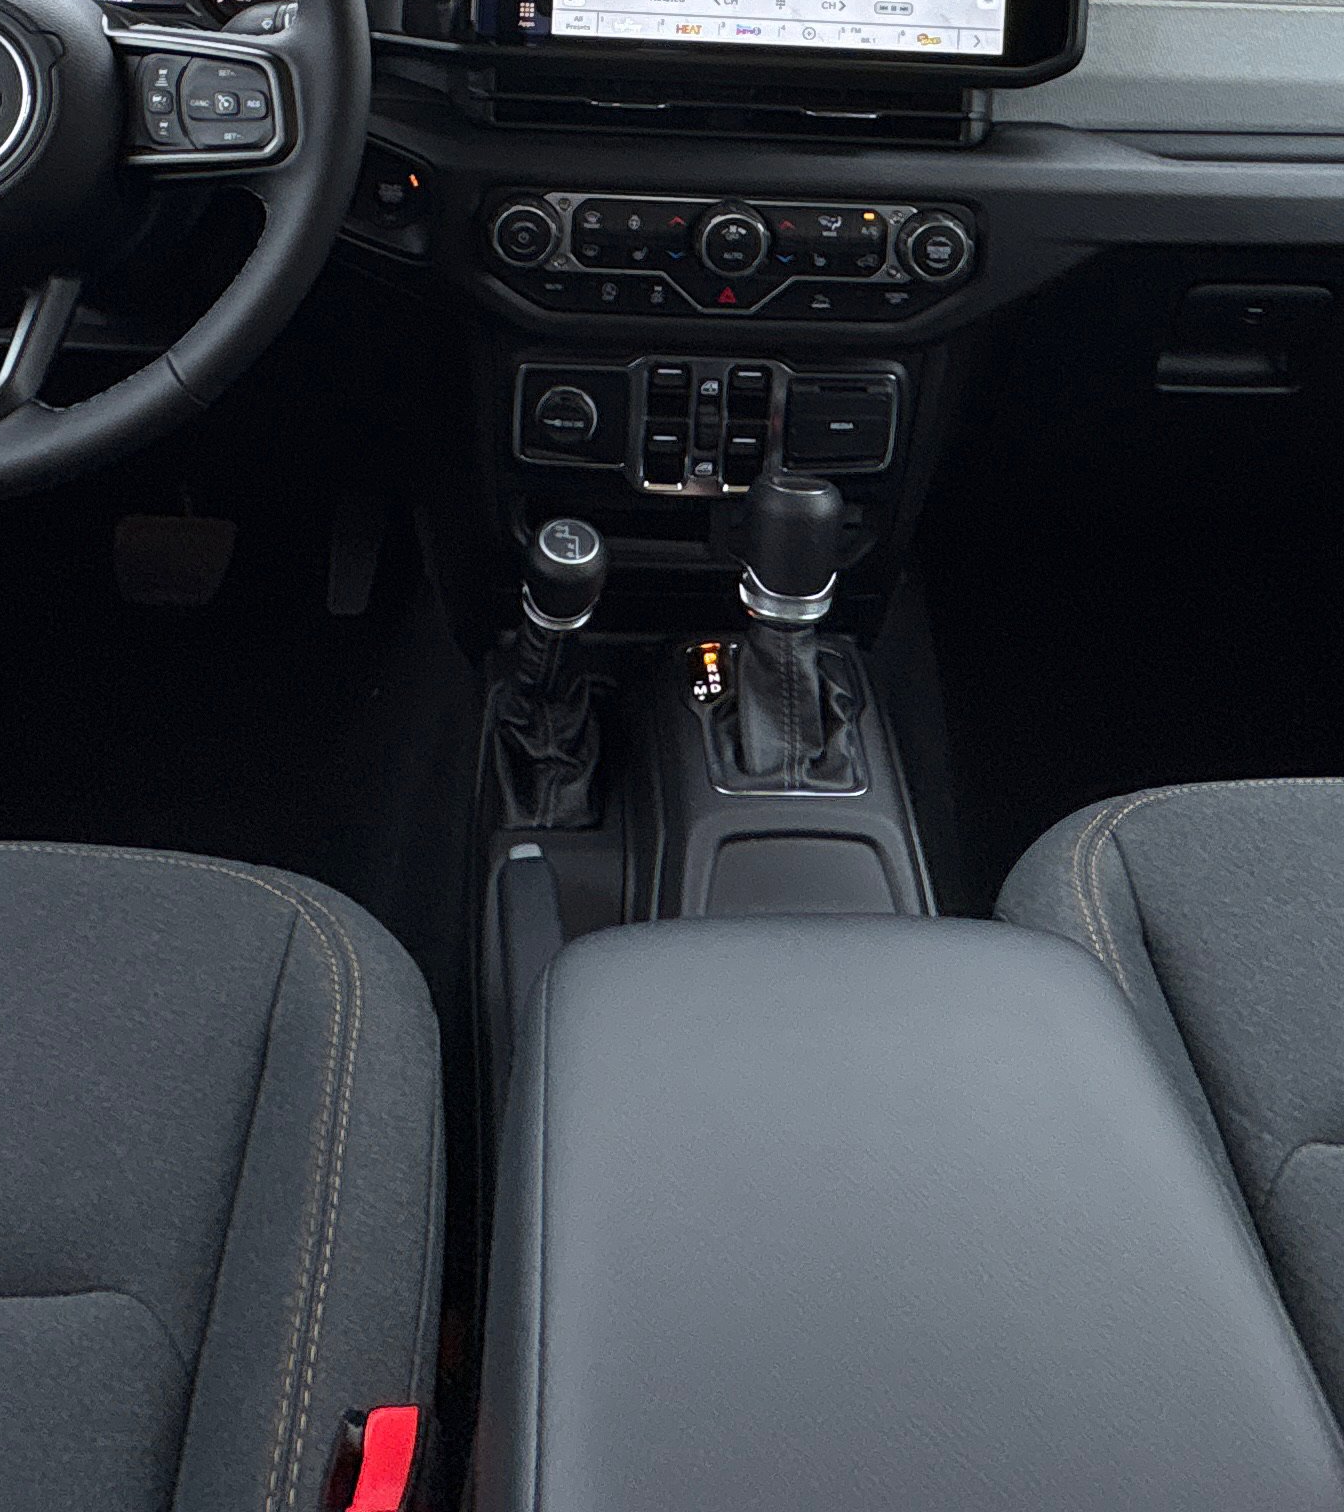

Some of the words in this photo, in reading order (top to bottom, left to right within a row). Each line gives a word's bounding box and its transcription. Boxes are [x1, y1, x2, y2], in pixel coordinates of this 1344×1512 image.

[821, 0, 837, 11] CH
[675, 23, 703, 35] HEAT
[708, 672, 721, 683] N
[693, 684, 708, 696] M
[710, 683, 722, 694] D
